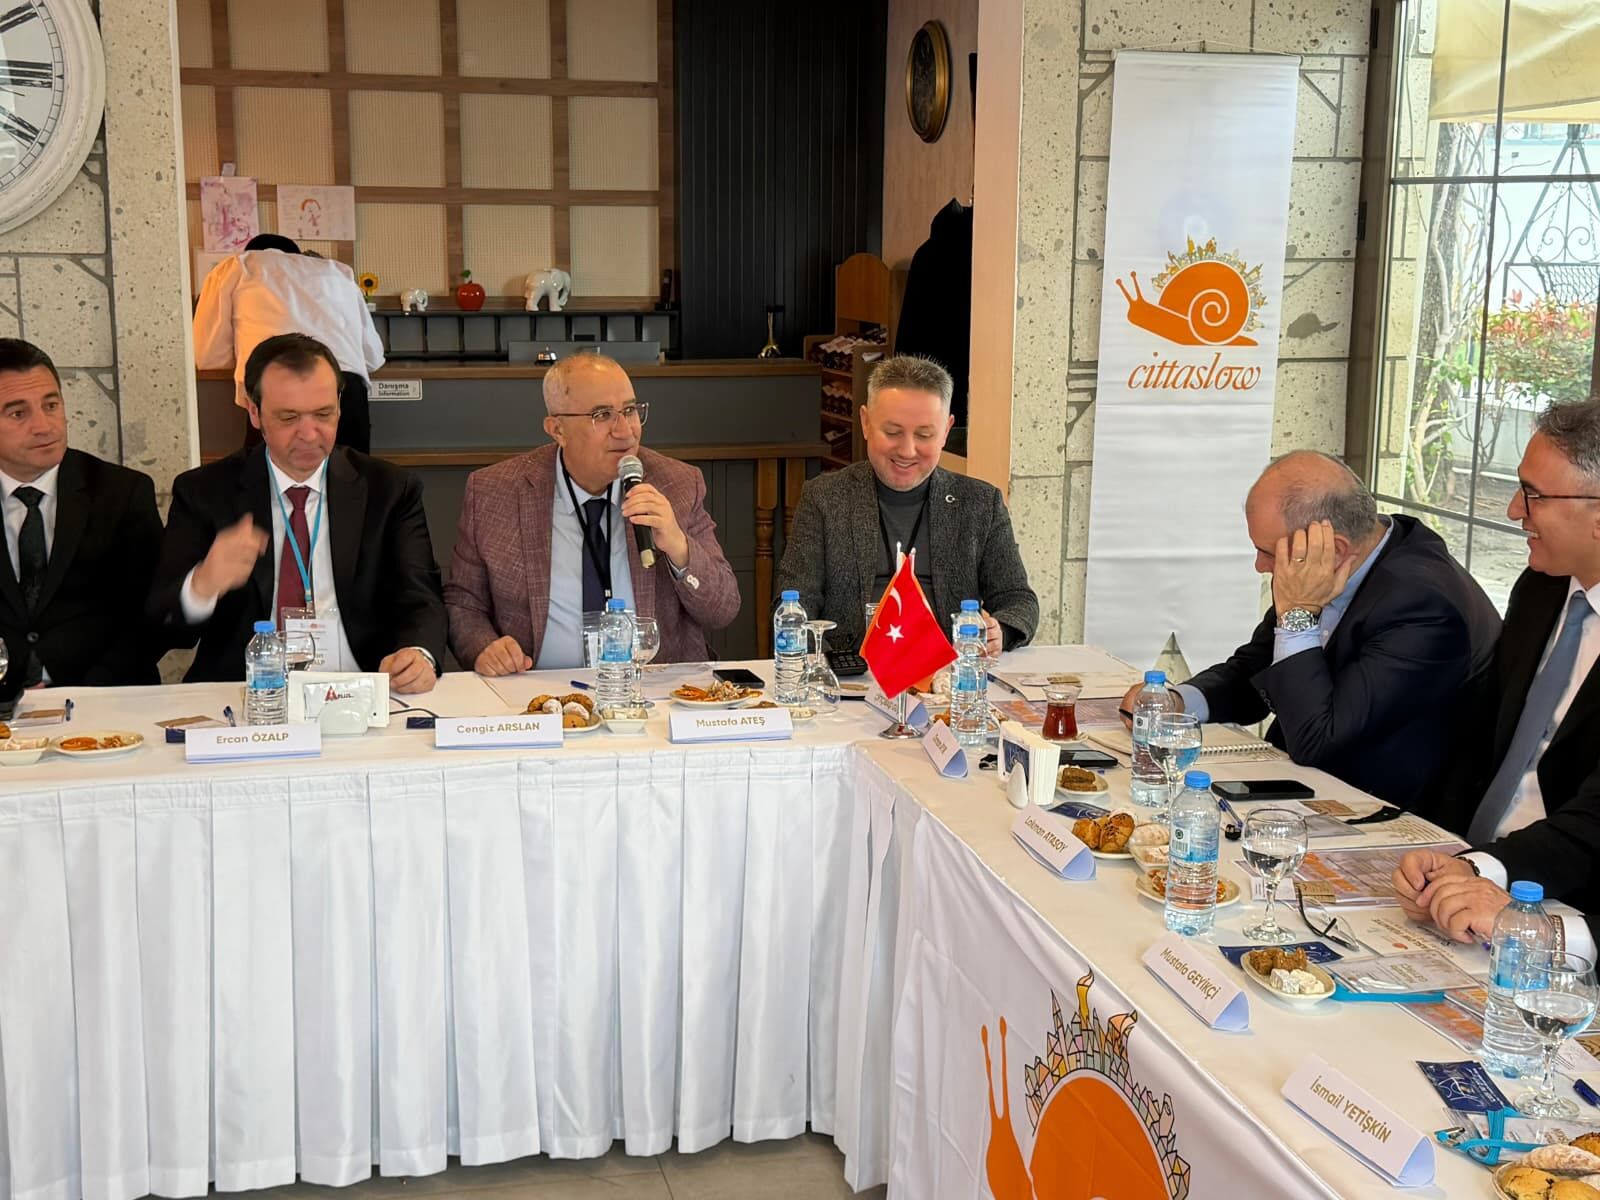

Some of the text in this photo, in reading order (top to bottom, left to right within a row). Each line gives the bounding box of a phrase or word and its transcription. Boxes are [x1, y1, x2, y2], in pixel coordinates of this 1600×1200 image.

[1127, 352, 1262, 391] cittaslow
[216, 731, 289, 745] Ercan ÖZALP
[456, 721, 540, 736] Cengiz ARSLAN
[695, 716, 766, 728] Mustafa ATEŞ
[1024, 815, 1069, 853] Lokman ATASOY
[1159, 947, 1222, 1000] Mustafa GEYİKÇİ
[1309, 1075, 1392, 1144] İsmail YETİŞKİN
